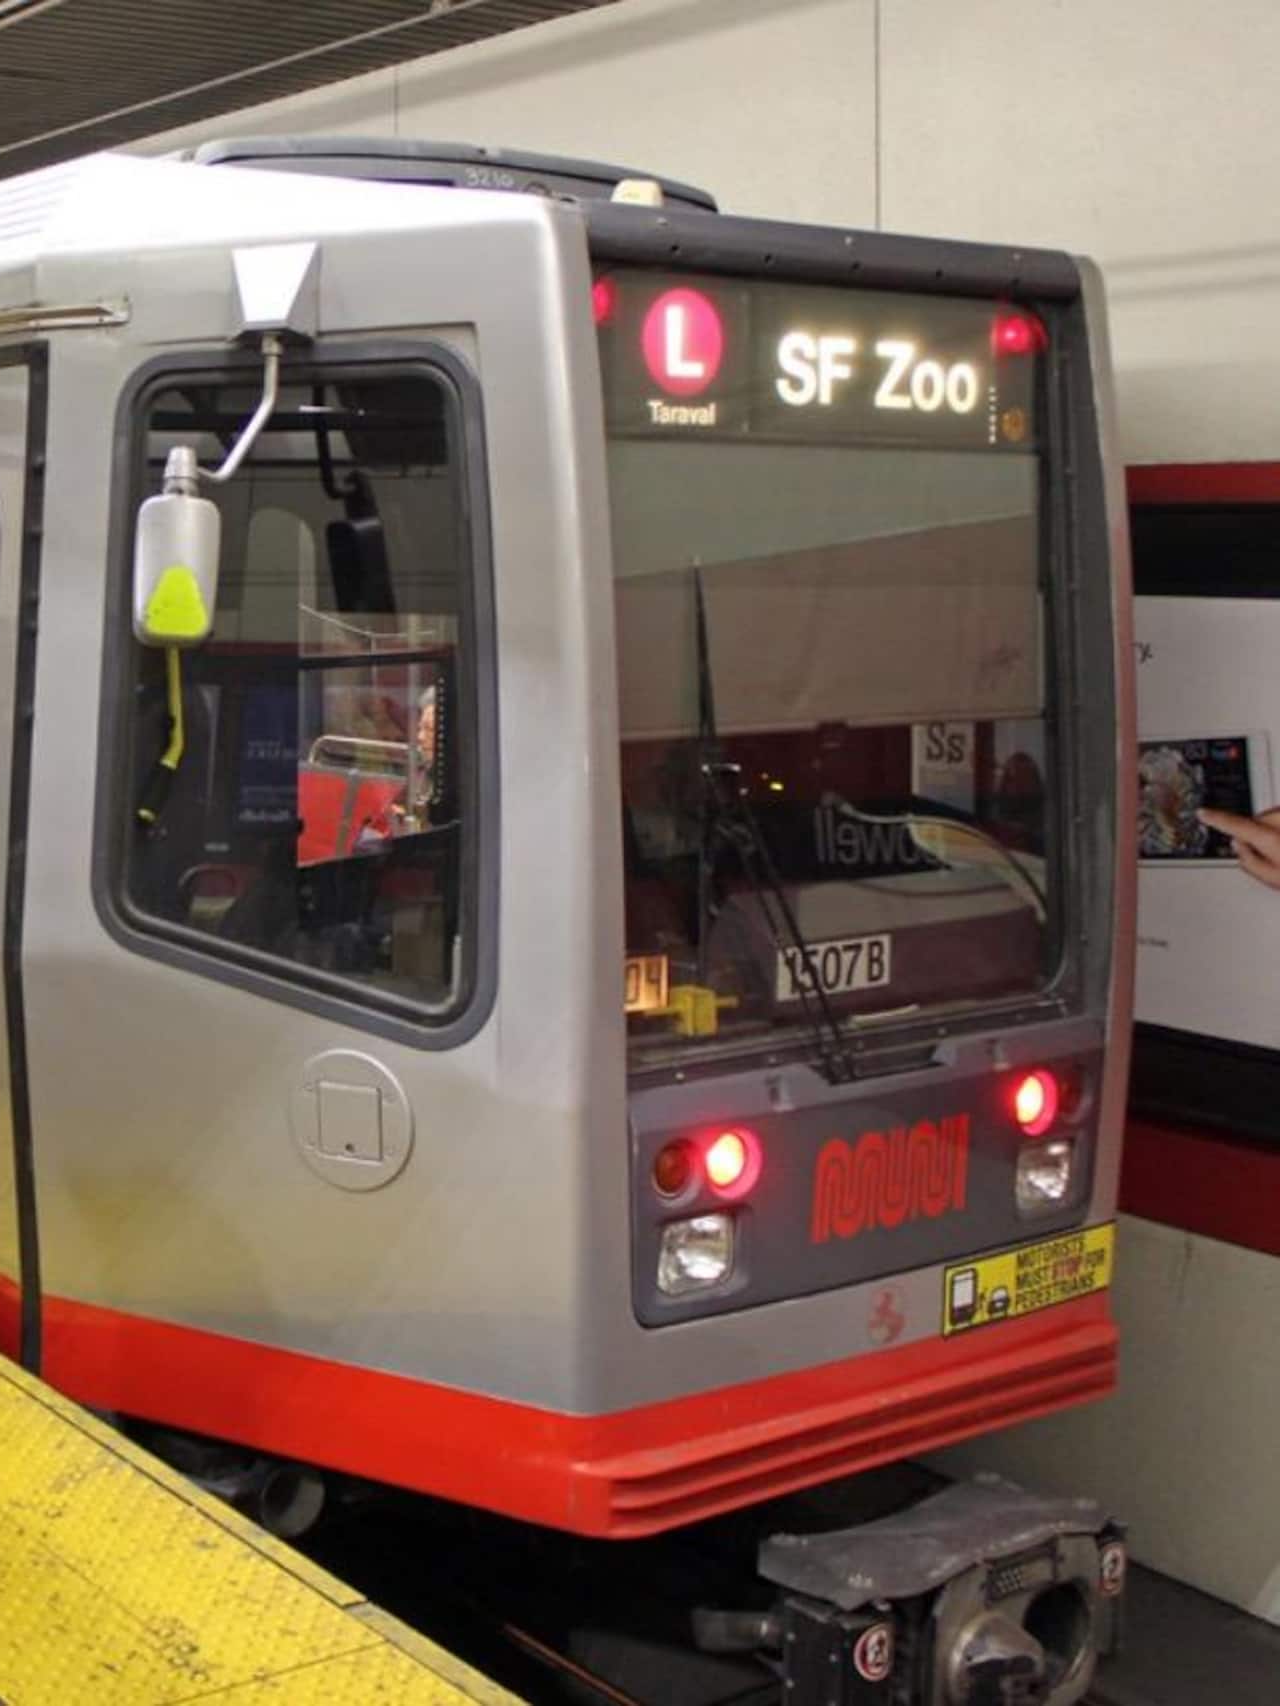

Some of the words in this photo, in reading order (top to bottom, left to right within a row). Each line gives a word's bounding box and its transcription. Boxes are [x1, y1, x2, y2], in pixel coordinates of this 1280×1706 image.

[664, 302, 705, 379] L
[775, 331, 857, 407] SF
[873, 338, 979, 414] Zoo
[647, 399, 716, 427] Taraval
[811, 1112, 969, 1245] MUNI
